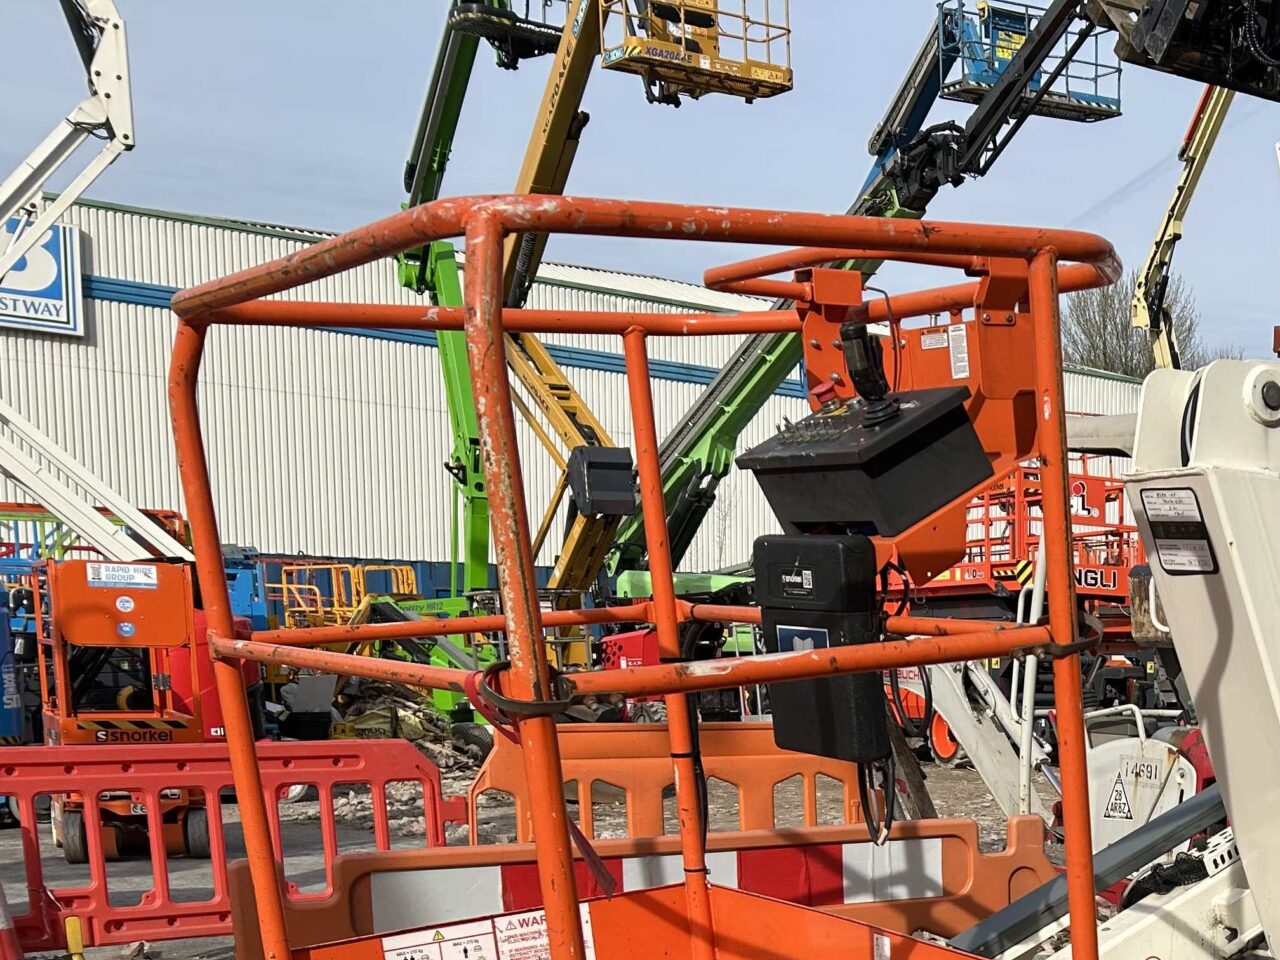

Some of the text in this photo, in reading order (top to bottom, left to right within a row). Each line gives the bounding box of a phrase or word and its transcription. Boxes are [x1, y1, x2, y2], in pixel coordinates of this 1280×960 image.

[105, 565, 130, 573] RAPID
[105, 574, 135, 582] GROUP
[110, 729, 173, 742] snorkel
[1125, 760, 1159, 781] 14691
